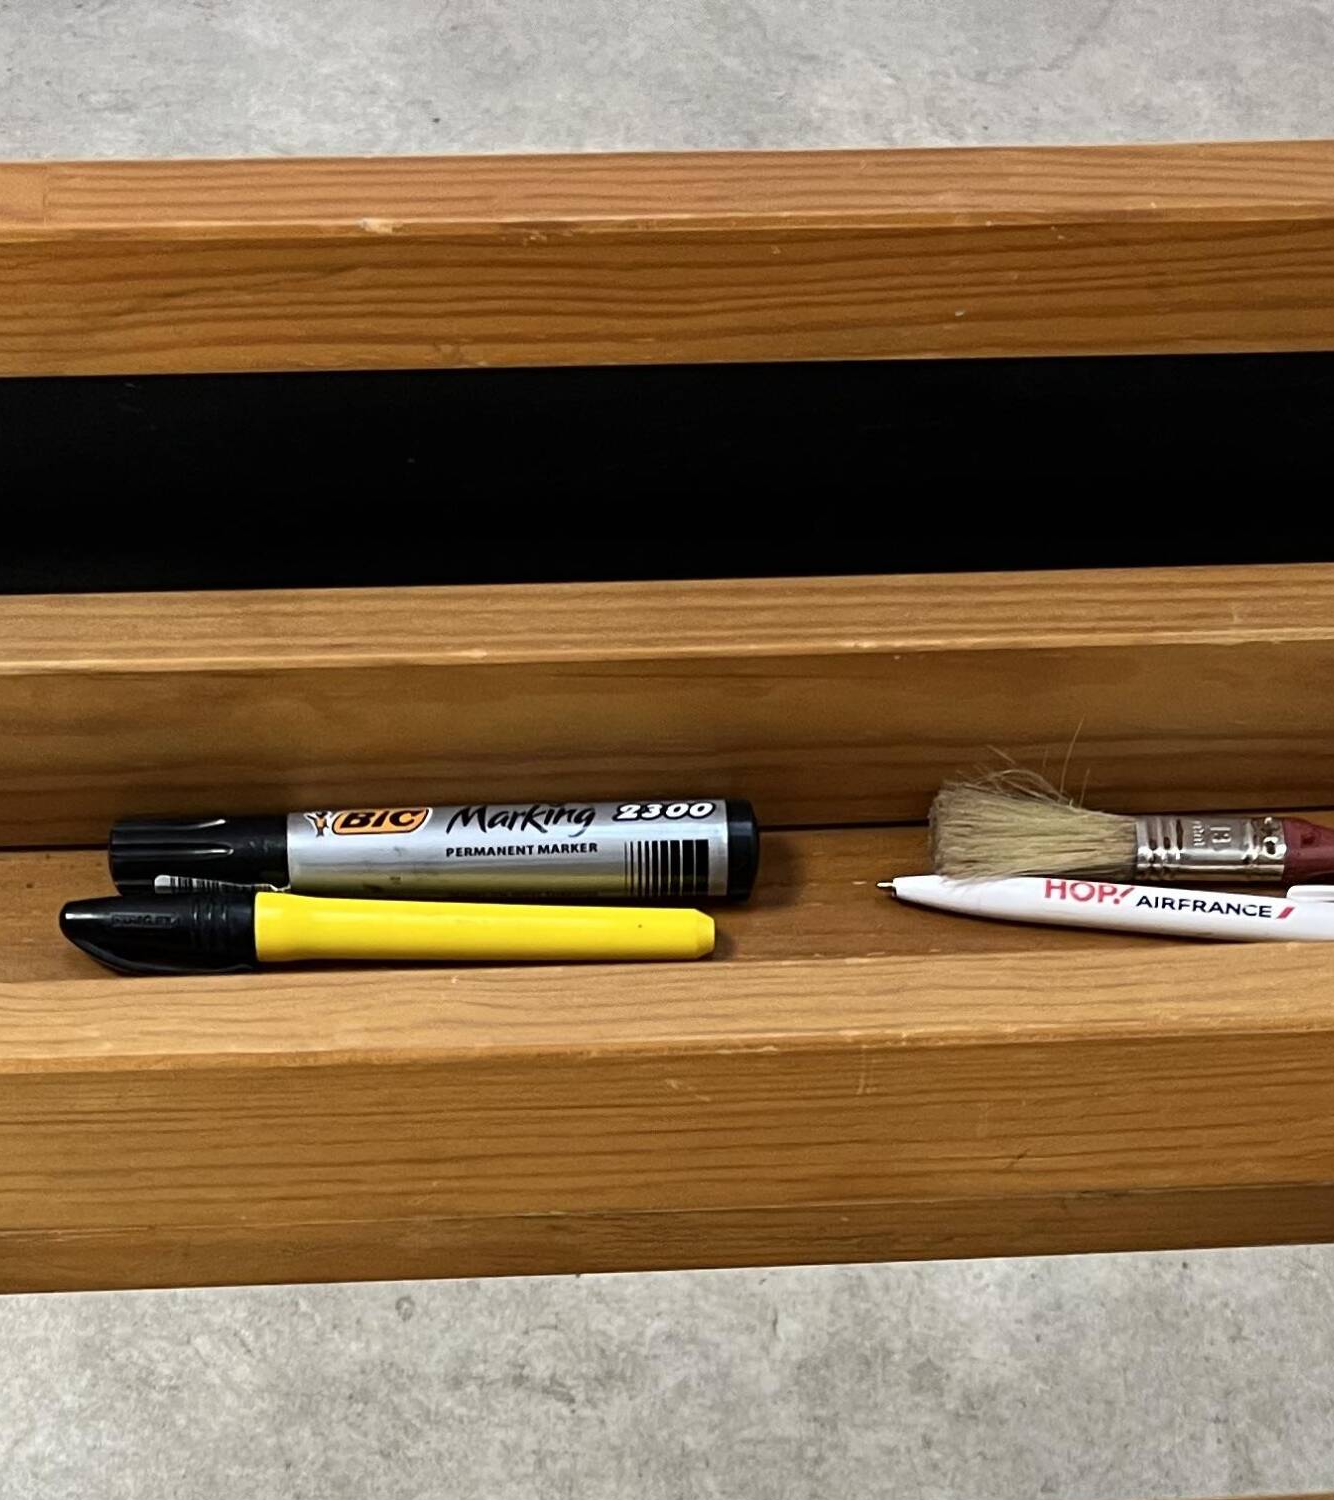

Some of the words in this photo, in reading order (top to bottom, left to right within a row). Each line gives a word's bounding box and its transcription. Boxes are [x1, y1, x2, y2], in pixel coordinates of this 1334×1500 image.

[339, 810, 425, 829] BIC
[445, 804, 596, 837] Marking
[613, 802, 716, 822] 2300
[445, 844, 535, 858] PERMANENT
[537, 842, 598, 855] MARKER
[1044, 878, 1135, 905] HOP!
[1136, 895, 1272, 919] AIRFRANCE
